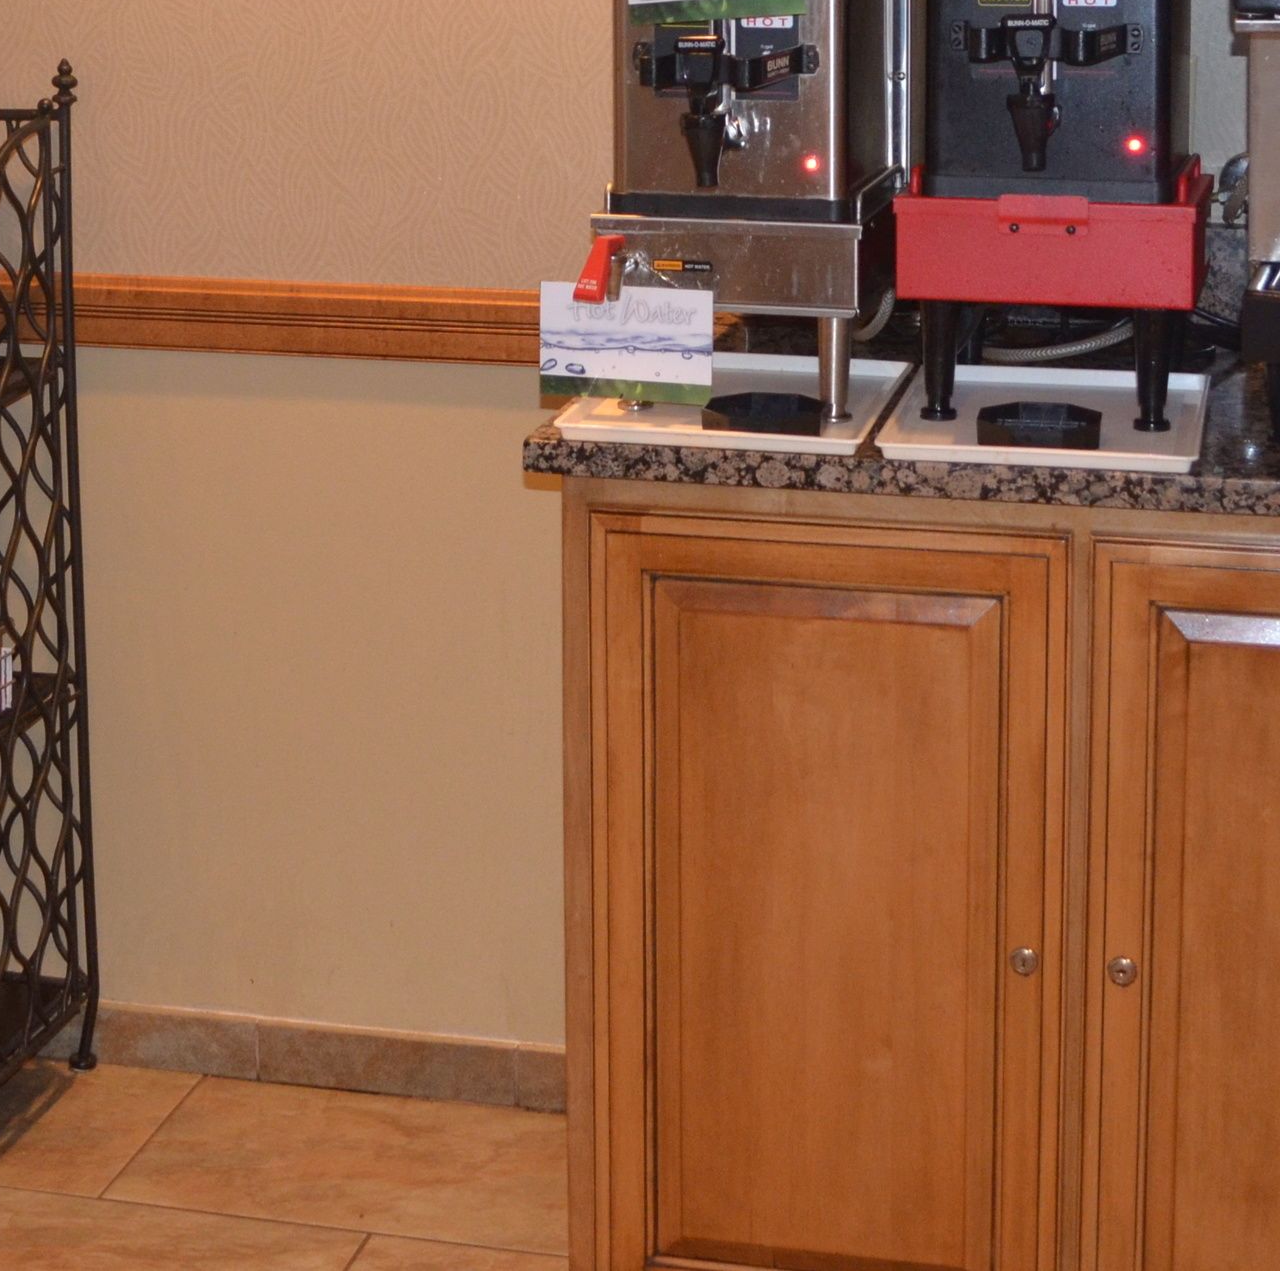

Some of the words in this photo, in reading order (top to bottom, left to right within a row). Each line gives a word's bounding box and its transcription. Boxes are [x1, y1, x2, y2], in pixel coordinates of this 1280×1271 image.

[746, 17, 789, 27] HOT
[1007, 19, 1050, 27] BUNN-O-MATIC
[766, 55, 790, 72] BUNN
[621, 295, 698, 326] Water
